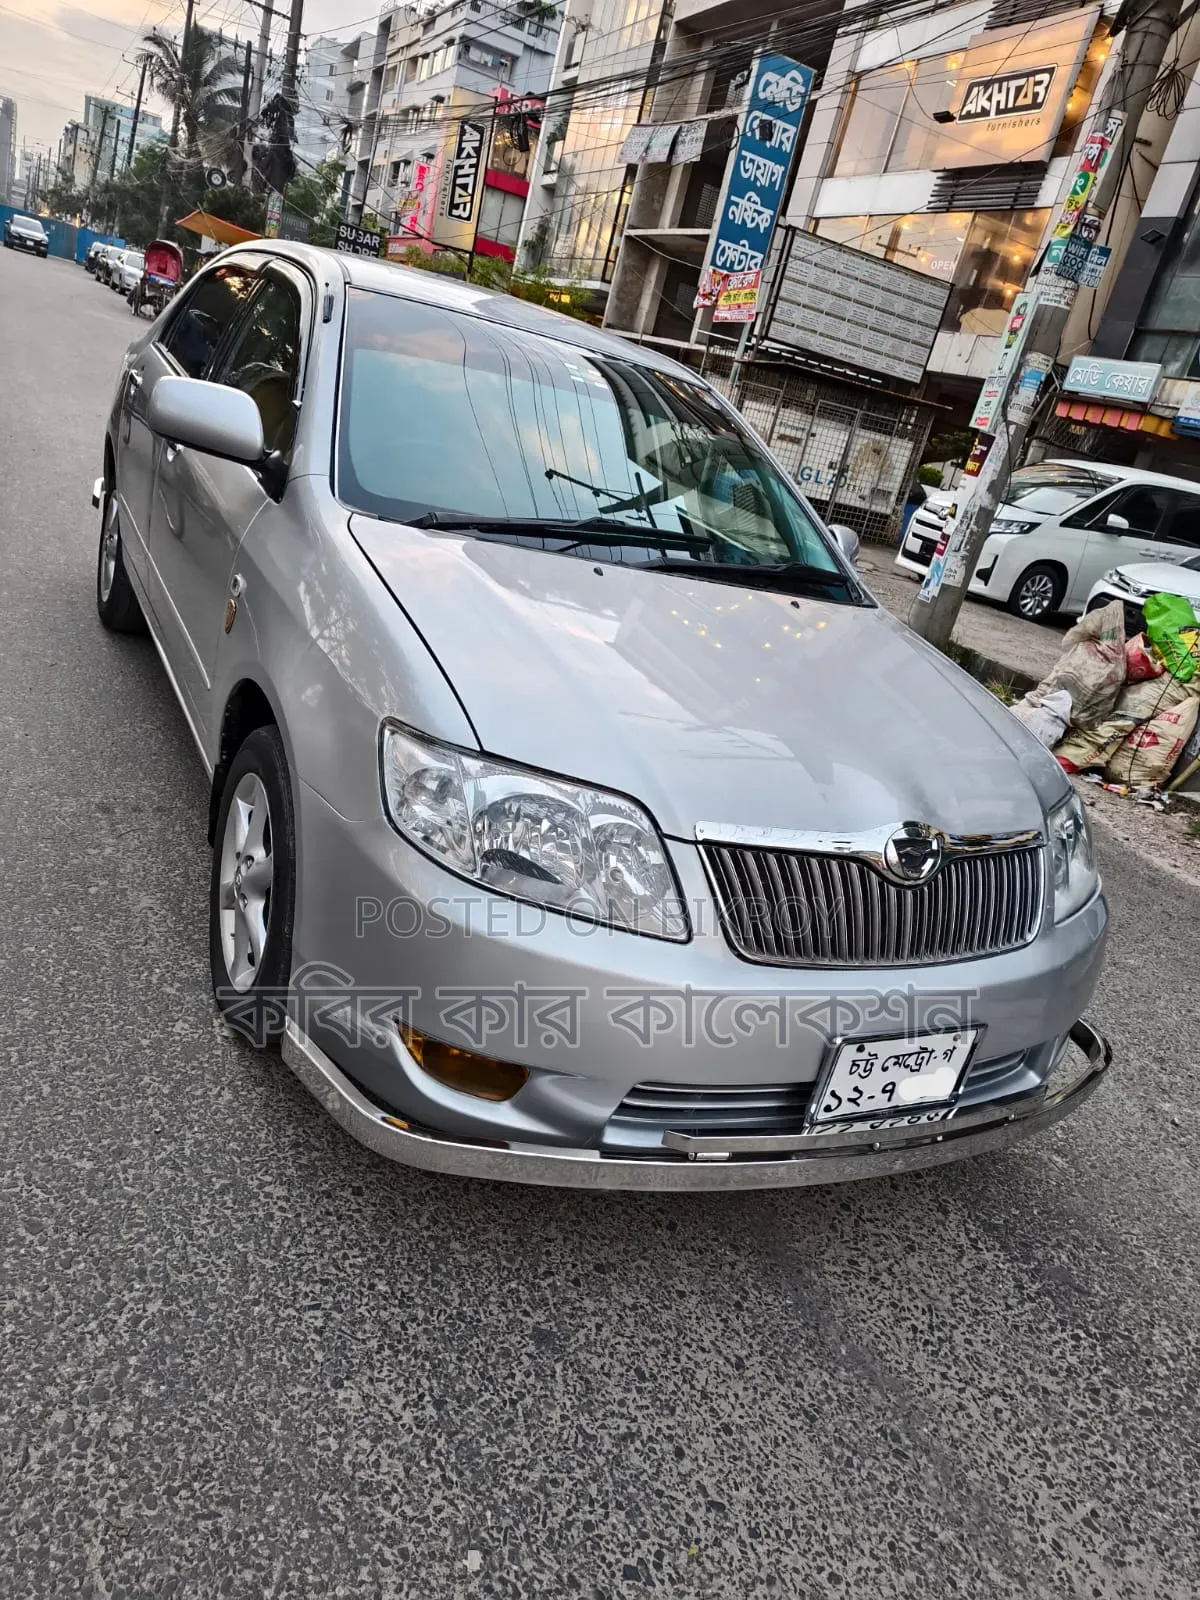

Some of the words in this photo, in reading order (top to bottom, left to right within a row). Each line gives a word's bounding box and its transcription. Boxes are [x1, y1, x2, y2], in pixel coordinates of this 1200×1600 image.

[961, 72, 1050, 118] AKHTAR
[986, 118, 1041, 132] furnishers
[451, 124, 480, 219] AKHTAR
[740, 151, 785, 191] ডায়াগ
[1067, 242, 1088, 260] WiFi
[1069, 363, 1104, 387] মেডি
[1105, 372, 1154, 396] কেয়ার
